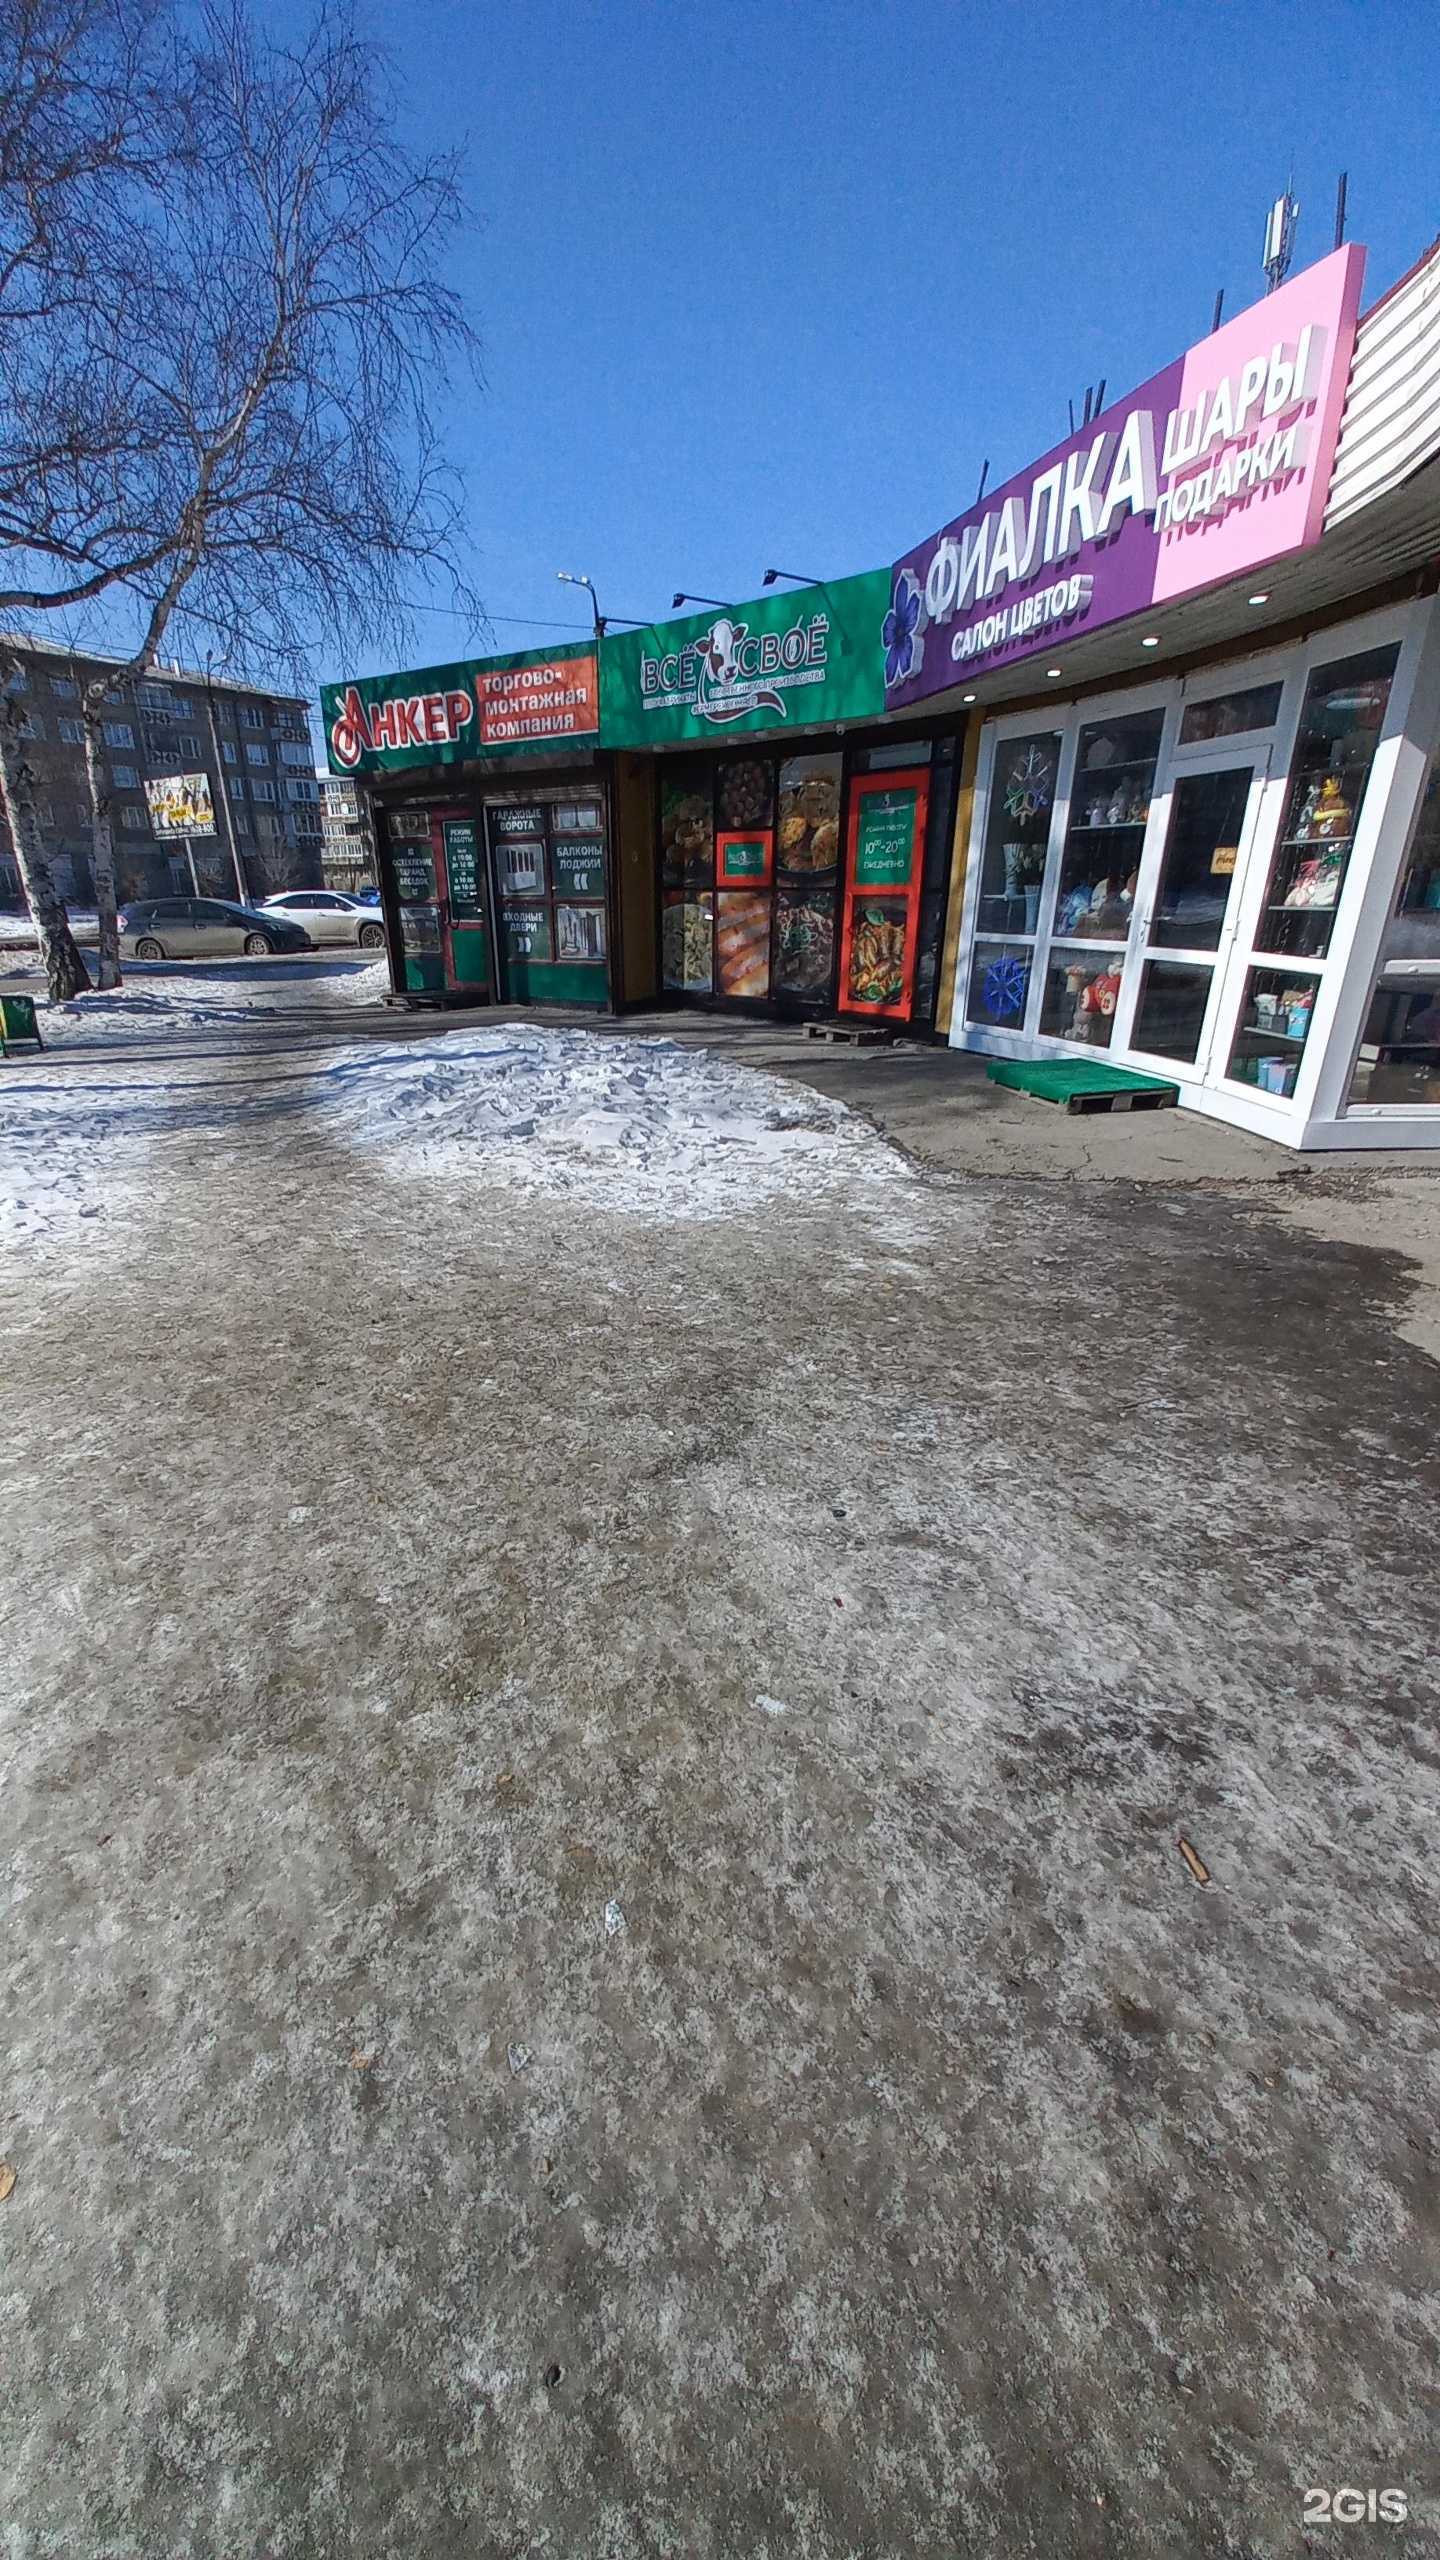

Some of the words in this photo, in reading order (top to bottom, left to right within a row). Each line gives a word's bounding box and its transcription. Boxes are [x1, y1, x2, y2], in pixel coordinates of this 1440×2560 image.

[1161, 324, 1318, 476] ШАРЫ
[1153, 424, 1303, 533] ПОДАРКИ
[926, 410, 1154, 625] ФИАЛКА
[951, 613, 1008, 661] САЛОН
[1010, 574, 1086, 636] ЦВЕТОВ
[641, 643, 697, 695] ВСЁ
[738, 613, 829, 677] СВОЁ
[331, 686, 473, 768] АНКЕР
[493, 808, 542, 821] ГАРАЖНЫЕ
[500, 820, 535, 831] ВОРОТА
[557, 845, 602, 857] БАЛКОНЫ
[560, 859, 601, 871] ЛОДЖИИ
[503, 912, 543, 923] ВХОДНЫЕ
[510, 922, 537, 933] ДВЕРИ
